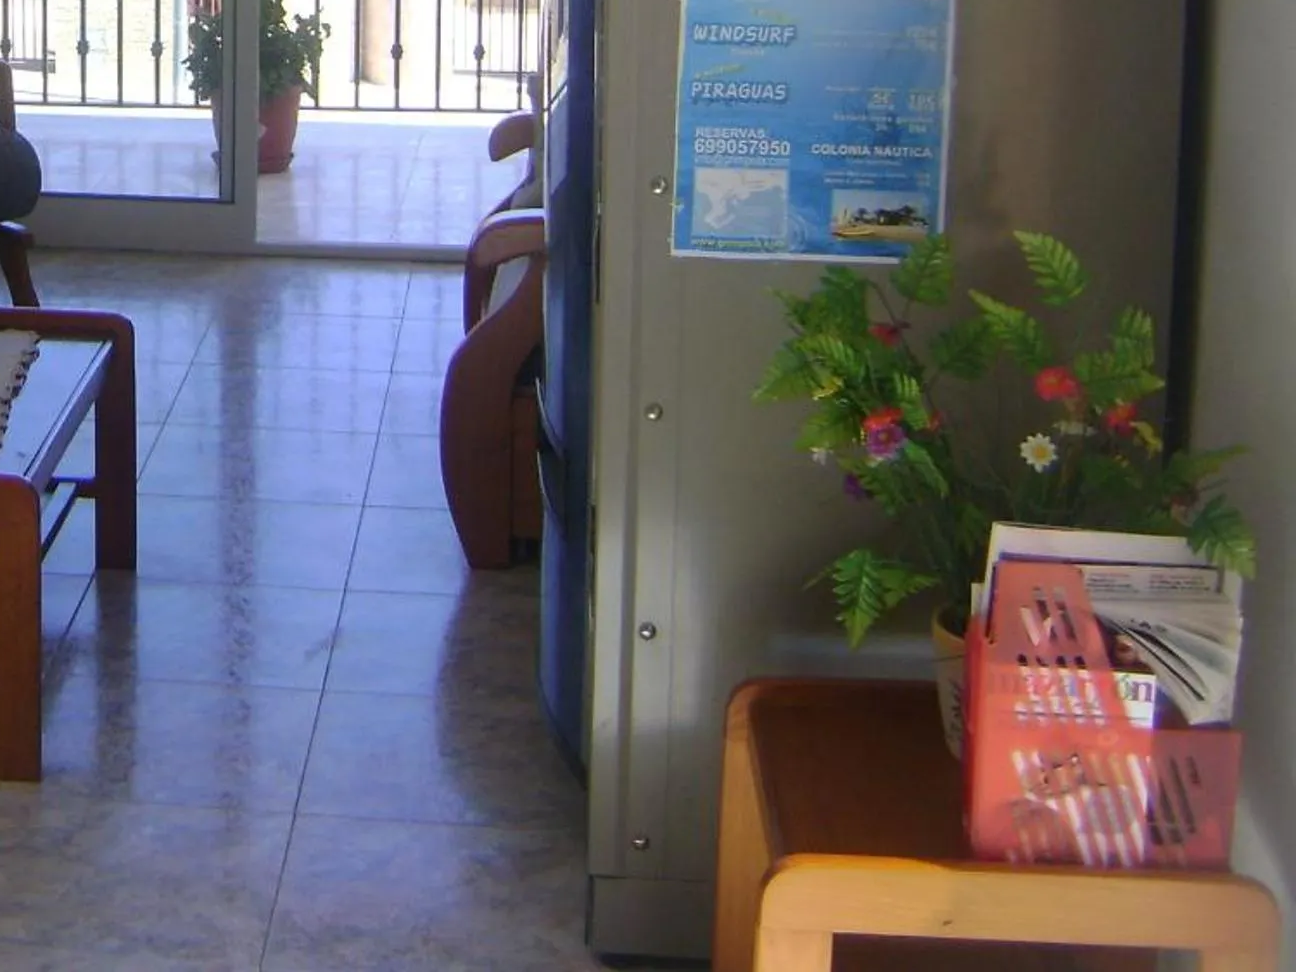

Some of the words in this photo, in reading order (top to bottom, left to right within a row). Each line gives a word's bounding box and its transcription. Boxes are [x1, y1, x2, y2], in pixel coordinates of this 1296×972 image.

[693, 24, 795, 44] WINDSURF
[691, 81, 787, 101] PIRAGUAS
[694, 138, 791, 156] 699057950
[811, 143, 870, 156] COLONIA
[873, 143, 932, 158] NAUTICA
